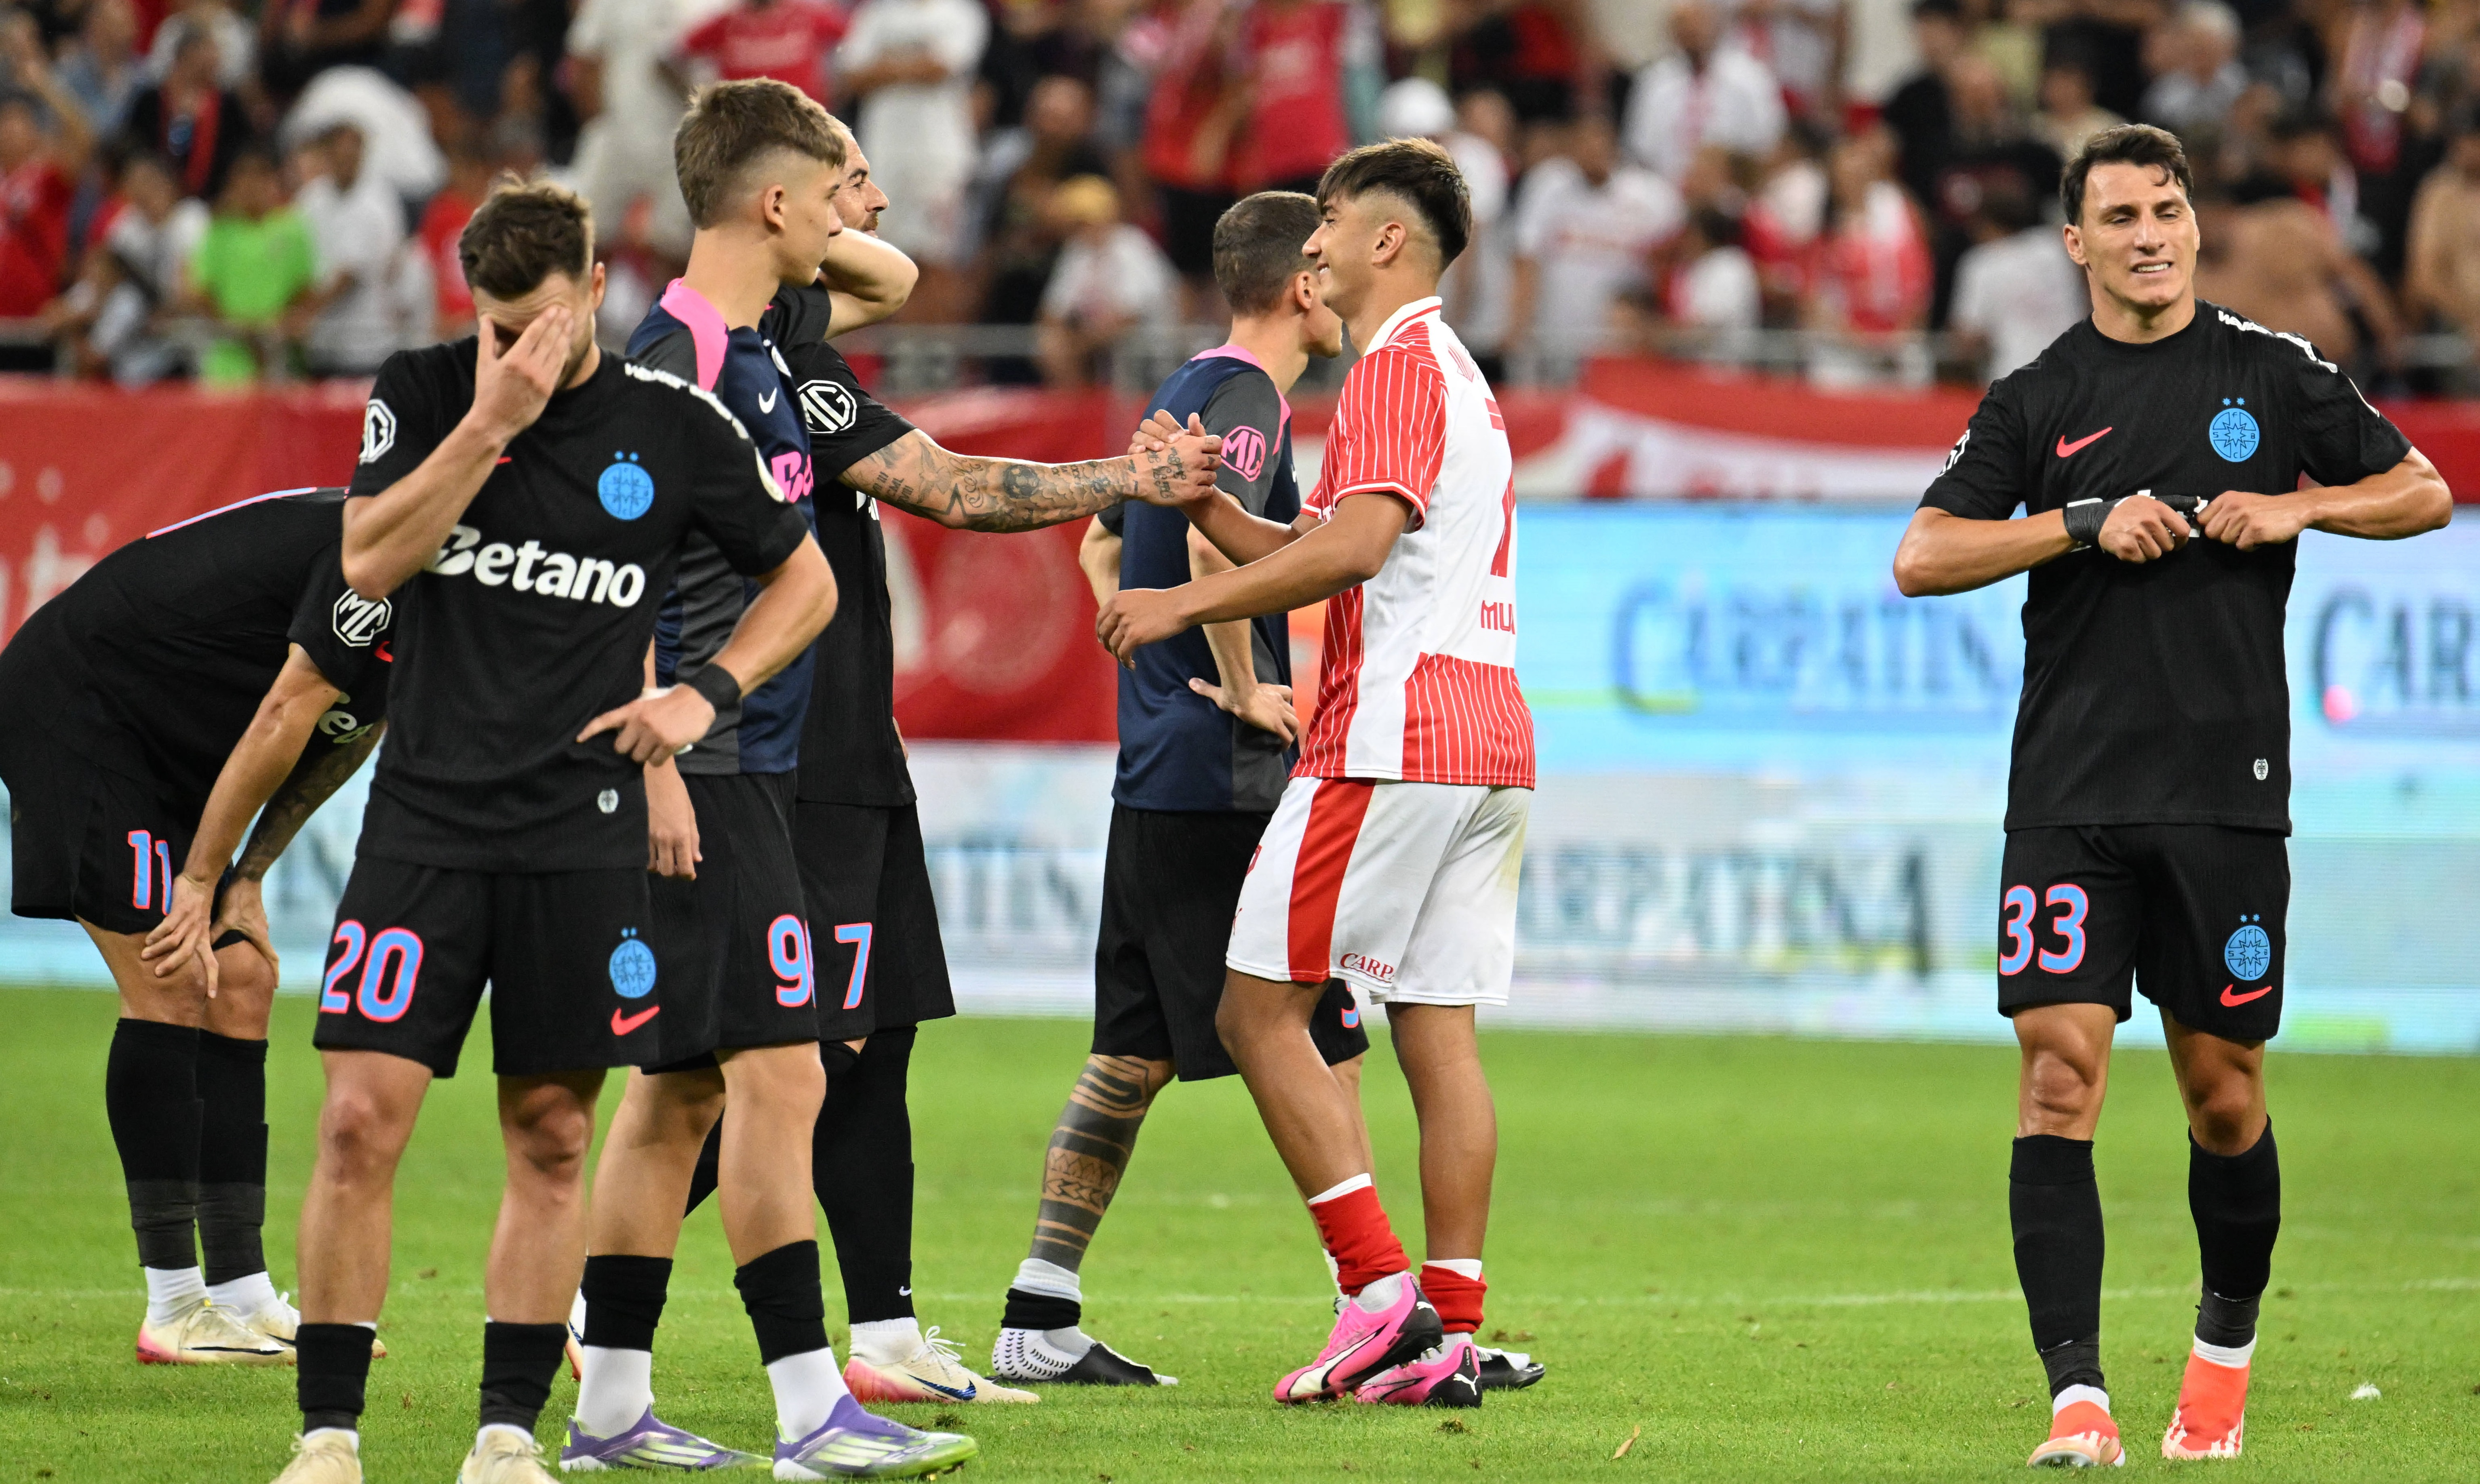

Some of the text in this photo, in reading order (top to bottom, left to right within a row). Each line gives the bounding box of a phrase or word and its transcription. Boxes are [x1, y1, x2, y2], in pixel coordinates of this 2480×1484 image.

[422, 524, 645, 608] Betano
[1480, 600, 1515, 635] MU
[320, 919, 424, 1023] 20
[767, 914, 816, 1009] 9
[834, 922, 873, 1010] 7
[1998, 884, 2089, 977] 33
